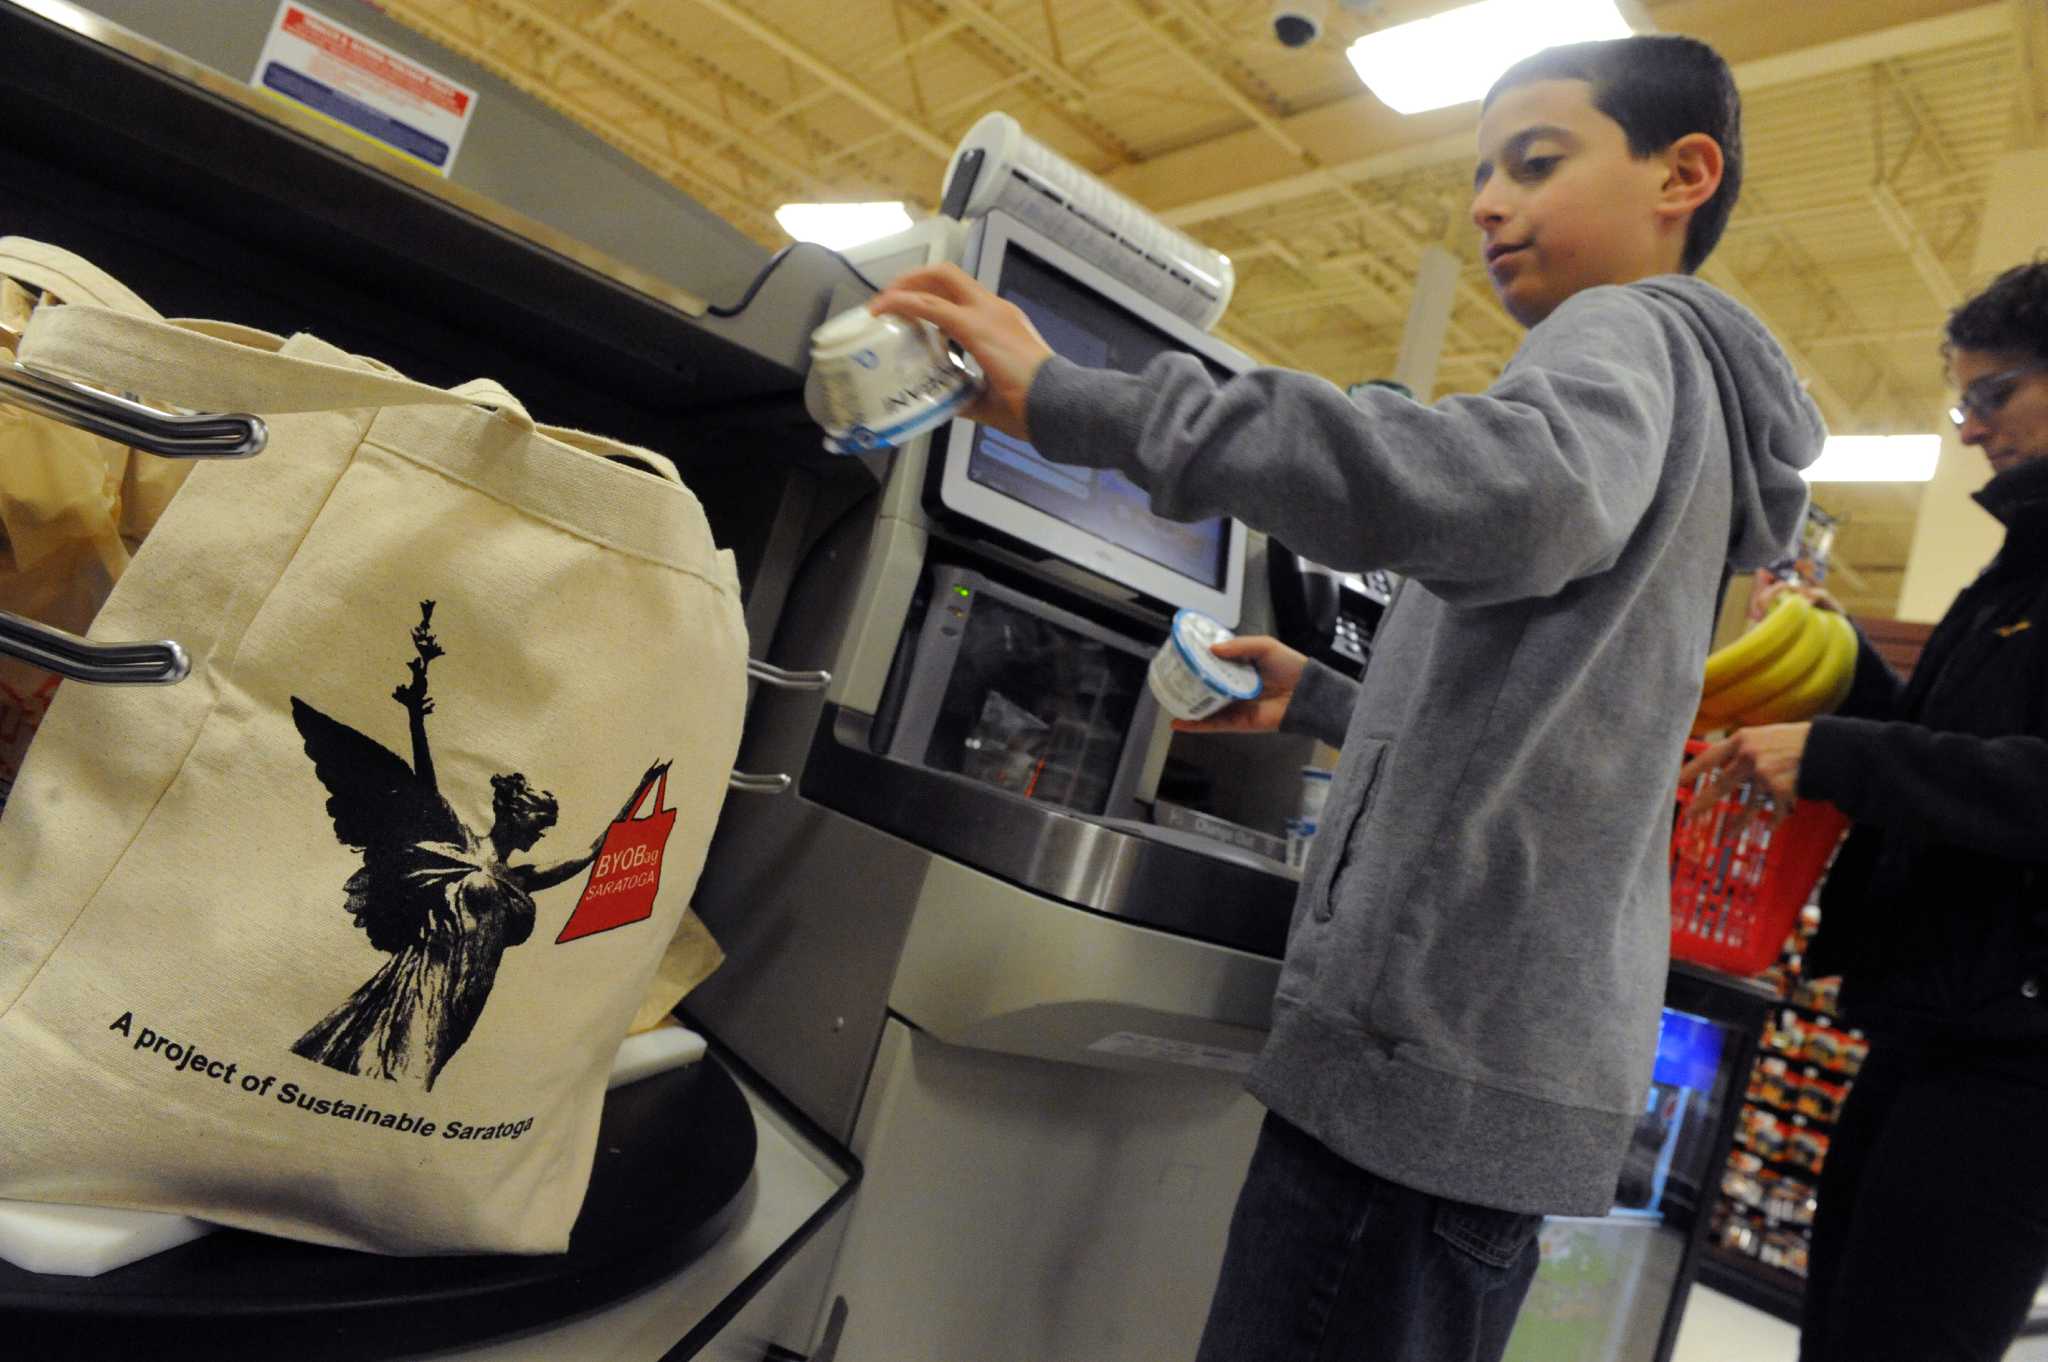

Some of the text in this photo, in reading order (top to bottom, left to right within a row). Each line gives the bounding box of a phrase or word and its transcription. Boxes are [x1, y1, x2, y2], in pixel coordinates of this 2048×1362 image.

[595, 844, 661, 878] BYOBag
[586, 870, 655, 901] SARATOGA
[109, 1011, 534, 1140] A project of Sustainable Saratoga
